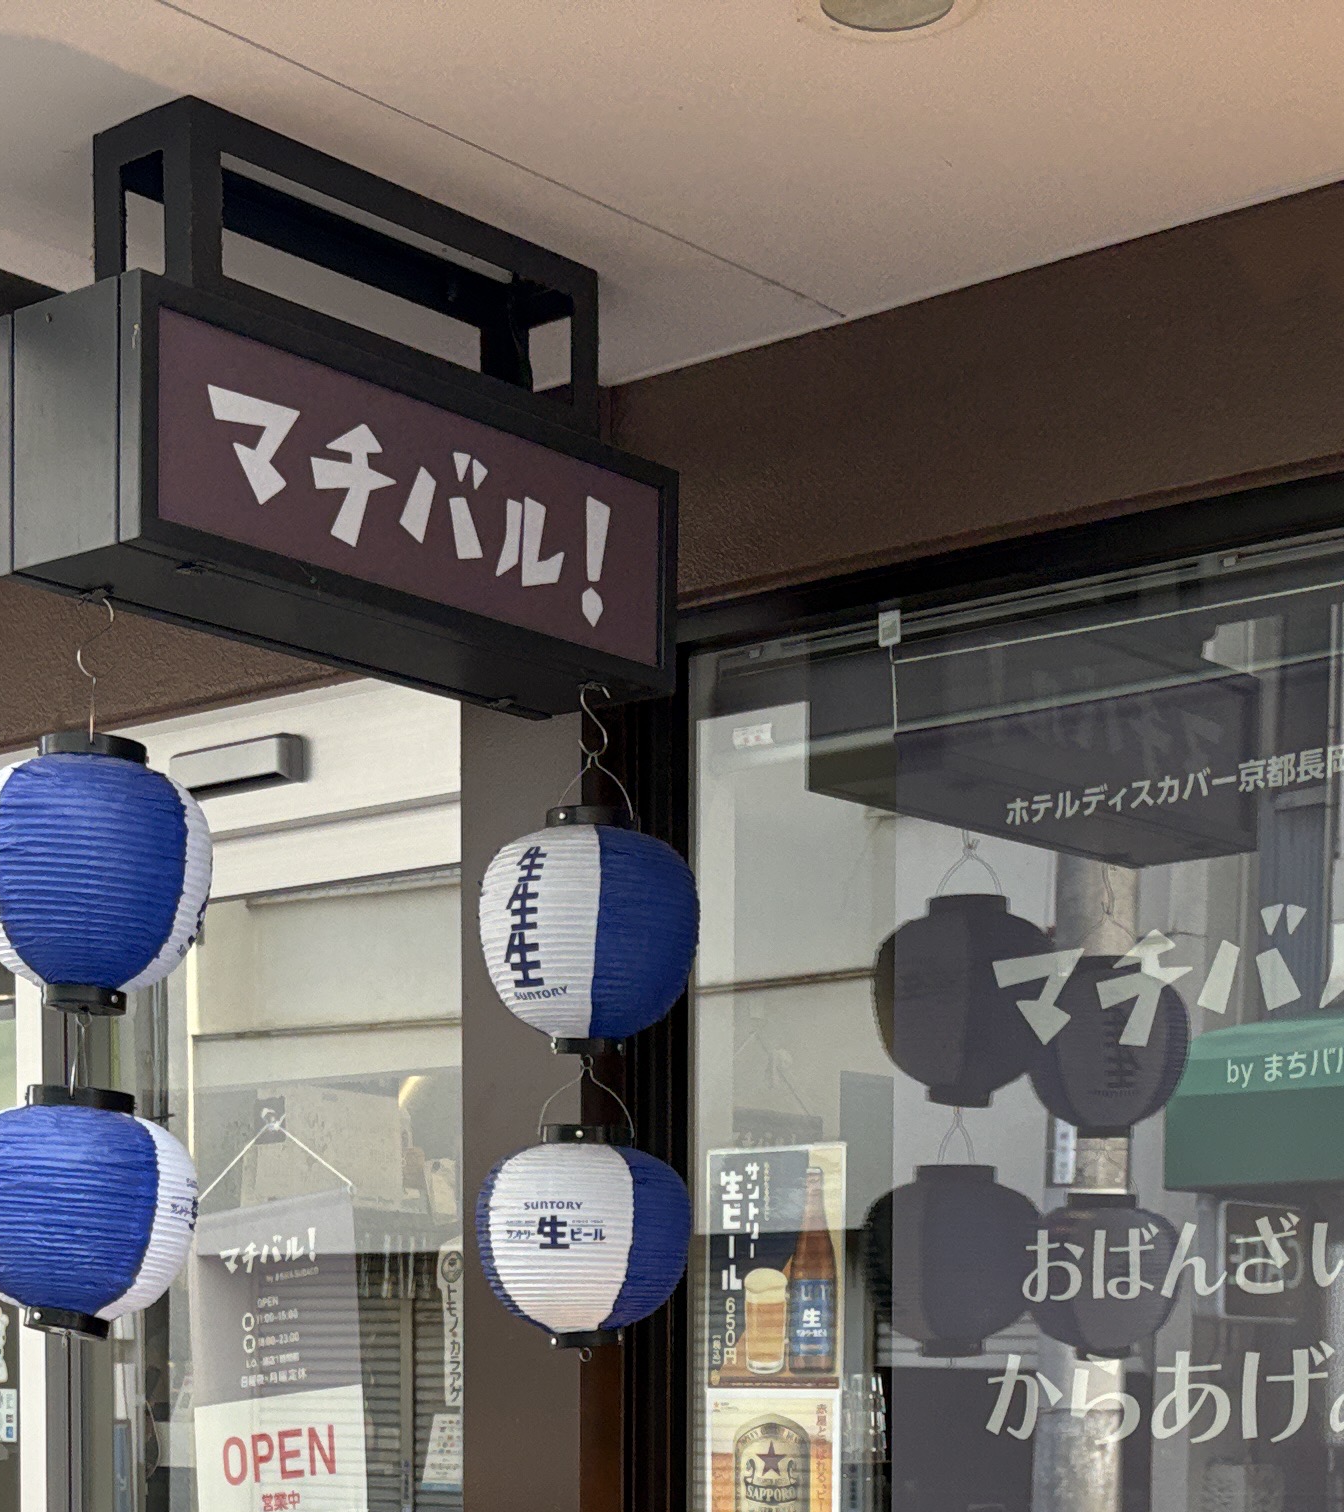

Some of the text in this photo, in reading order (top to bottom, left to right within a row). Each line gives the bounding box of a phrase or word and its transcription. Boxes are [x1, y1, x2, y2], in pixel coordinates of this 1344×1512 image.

[207, 384, 611, 626] マチバル!
[1227, 1057, 1253, 1084] by
[524, 1200, 583, 1210] SUNTORY
[720, 1170, 743, 1290] 生ビール
[219, 1227, 316, 1274] マチバル!
[802, 1308, 822, 1329] 生
[222, 1424, 338, 1486] OPEN
[261, 1490, 301, 1512] 営業中
[746, 1485, 796, 1502] SAPPORO
